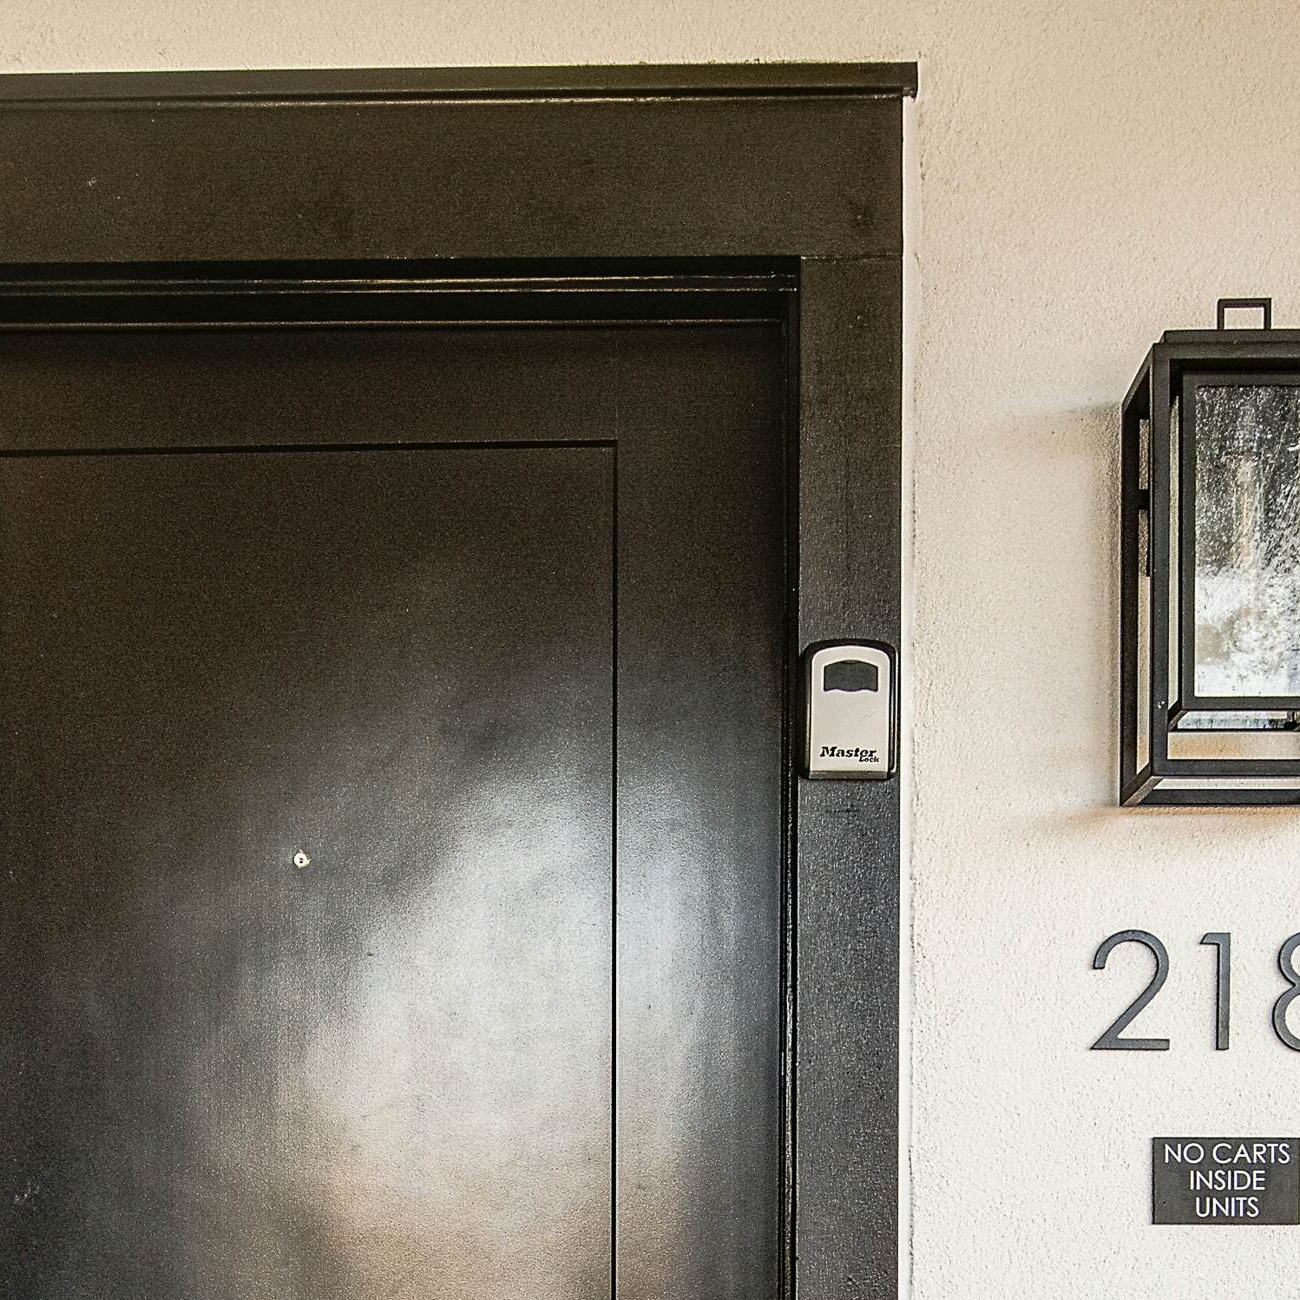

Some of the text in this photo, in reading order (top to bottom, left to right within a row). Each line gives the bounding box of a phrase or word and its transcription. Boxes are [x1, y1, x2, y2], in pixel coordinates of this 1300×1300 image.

[820, 746, 876, 757] Master
[1164, 1143, 1291, 1164] NO CARTS
[1189, 1169, 1266, 1191] INSIDE
[1195, 1196, 1259, 1218] UNITS
